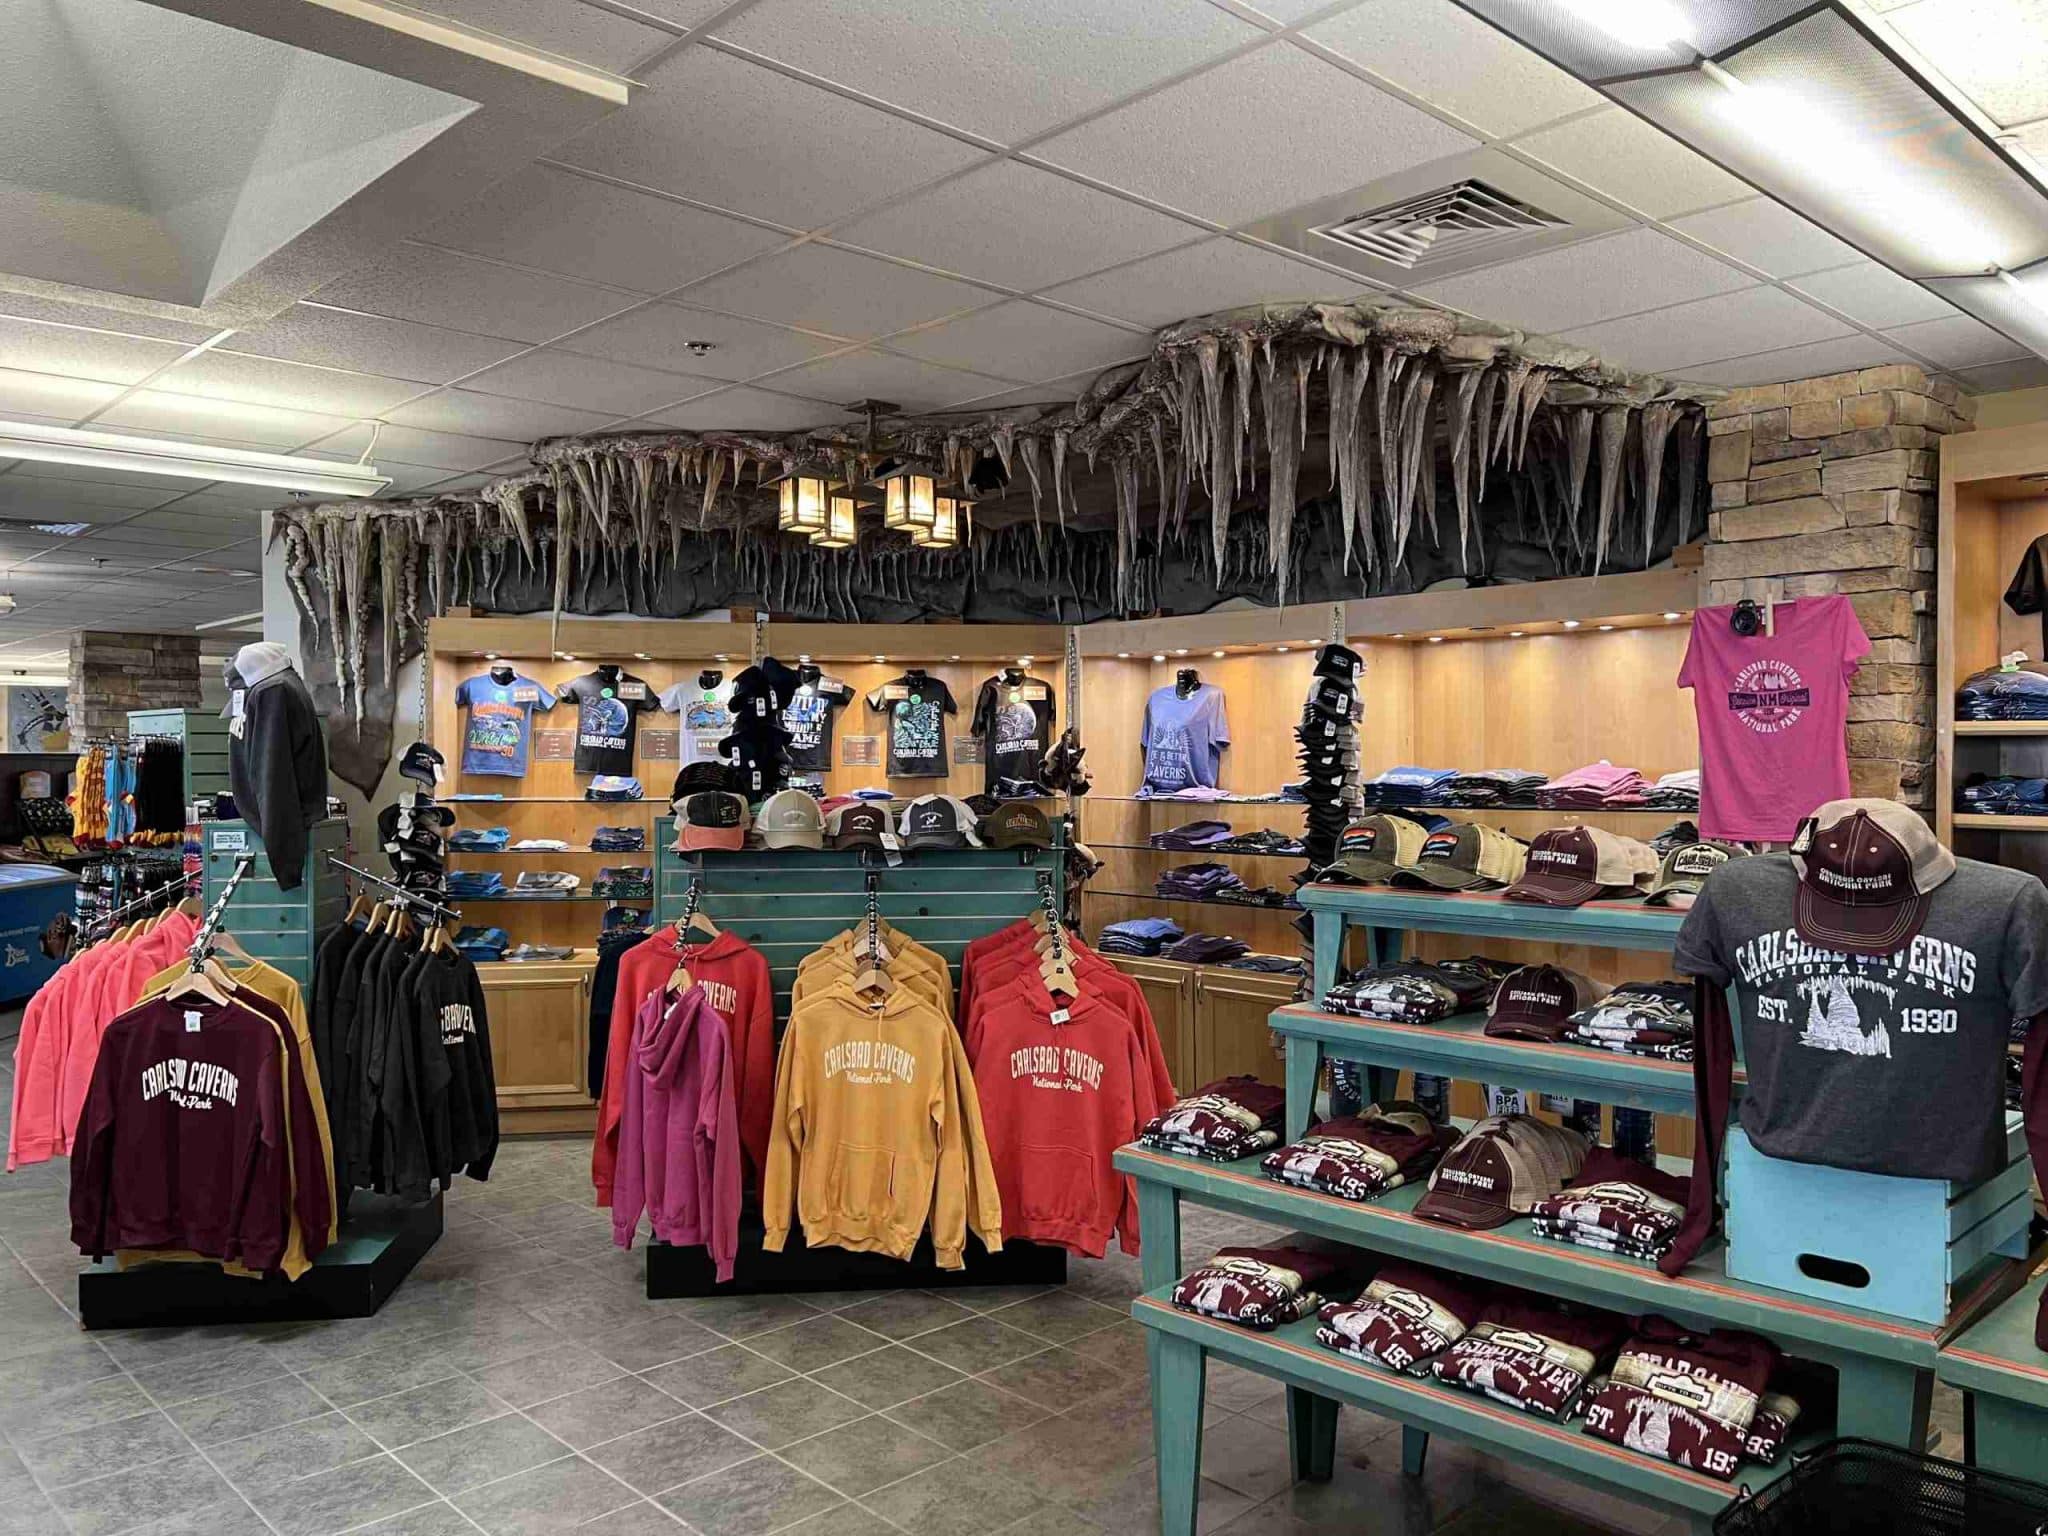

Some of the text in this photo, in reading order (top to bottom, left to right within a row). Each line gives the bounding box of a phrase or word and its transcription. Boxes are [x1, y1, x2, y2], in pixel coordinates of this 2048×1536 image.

[1735, 660, 1801, 688] CARLSBAD CAVERNS
[1738, 707, 1801, 733] NATIONAL PARK
[1754, 963, 1956, 999] NATIONAL PARK
[1758, 994, 1957, 1034] EST. 1930
[824, 1041, 917, 1084] CARLSBAD CAVERNS
[1011, 1045, 1104, 1091] CARLSBAD CAVERNS
[188, 1061, 239, 1107] CAVERNS
[1496, 1095, 1518, 1106] BPA
